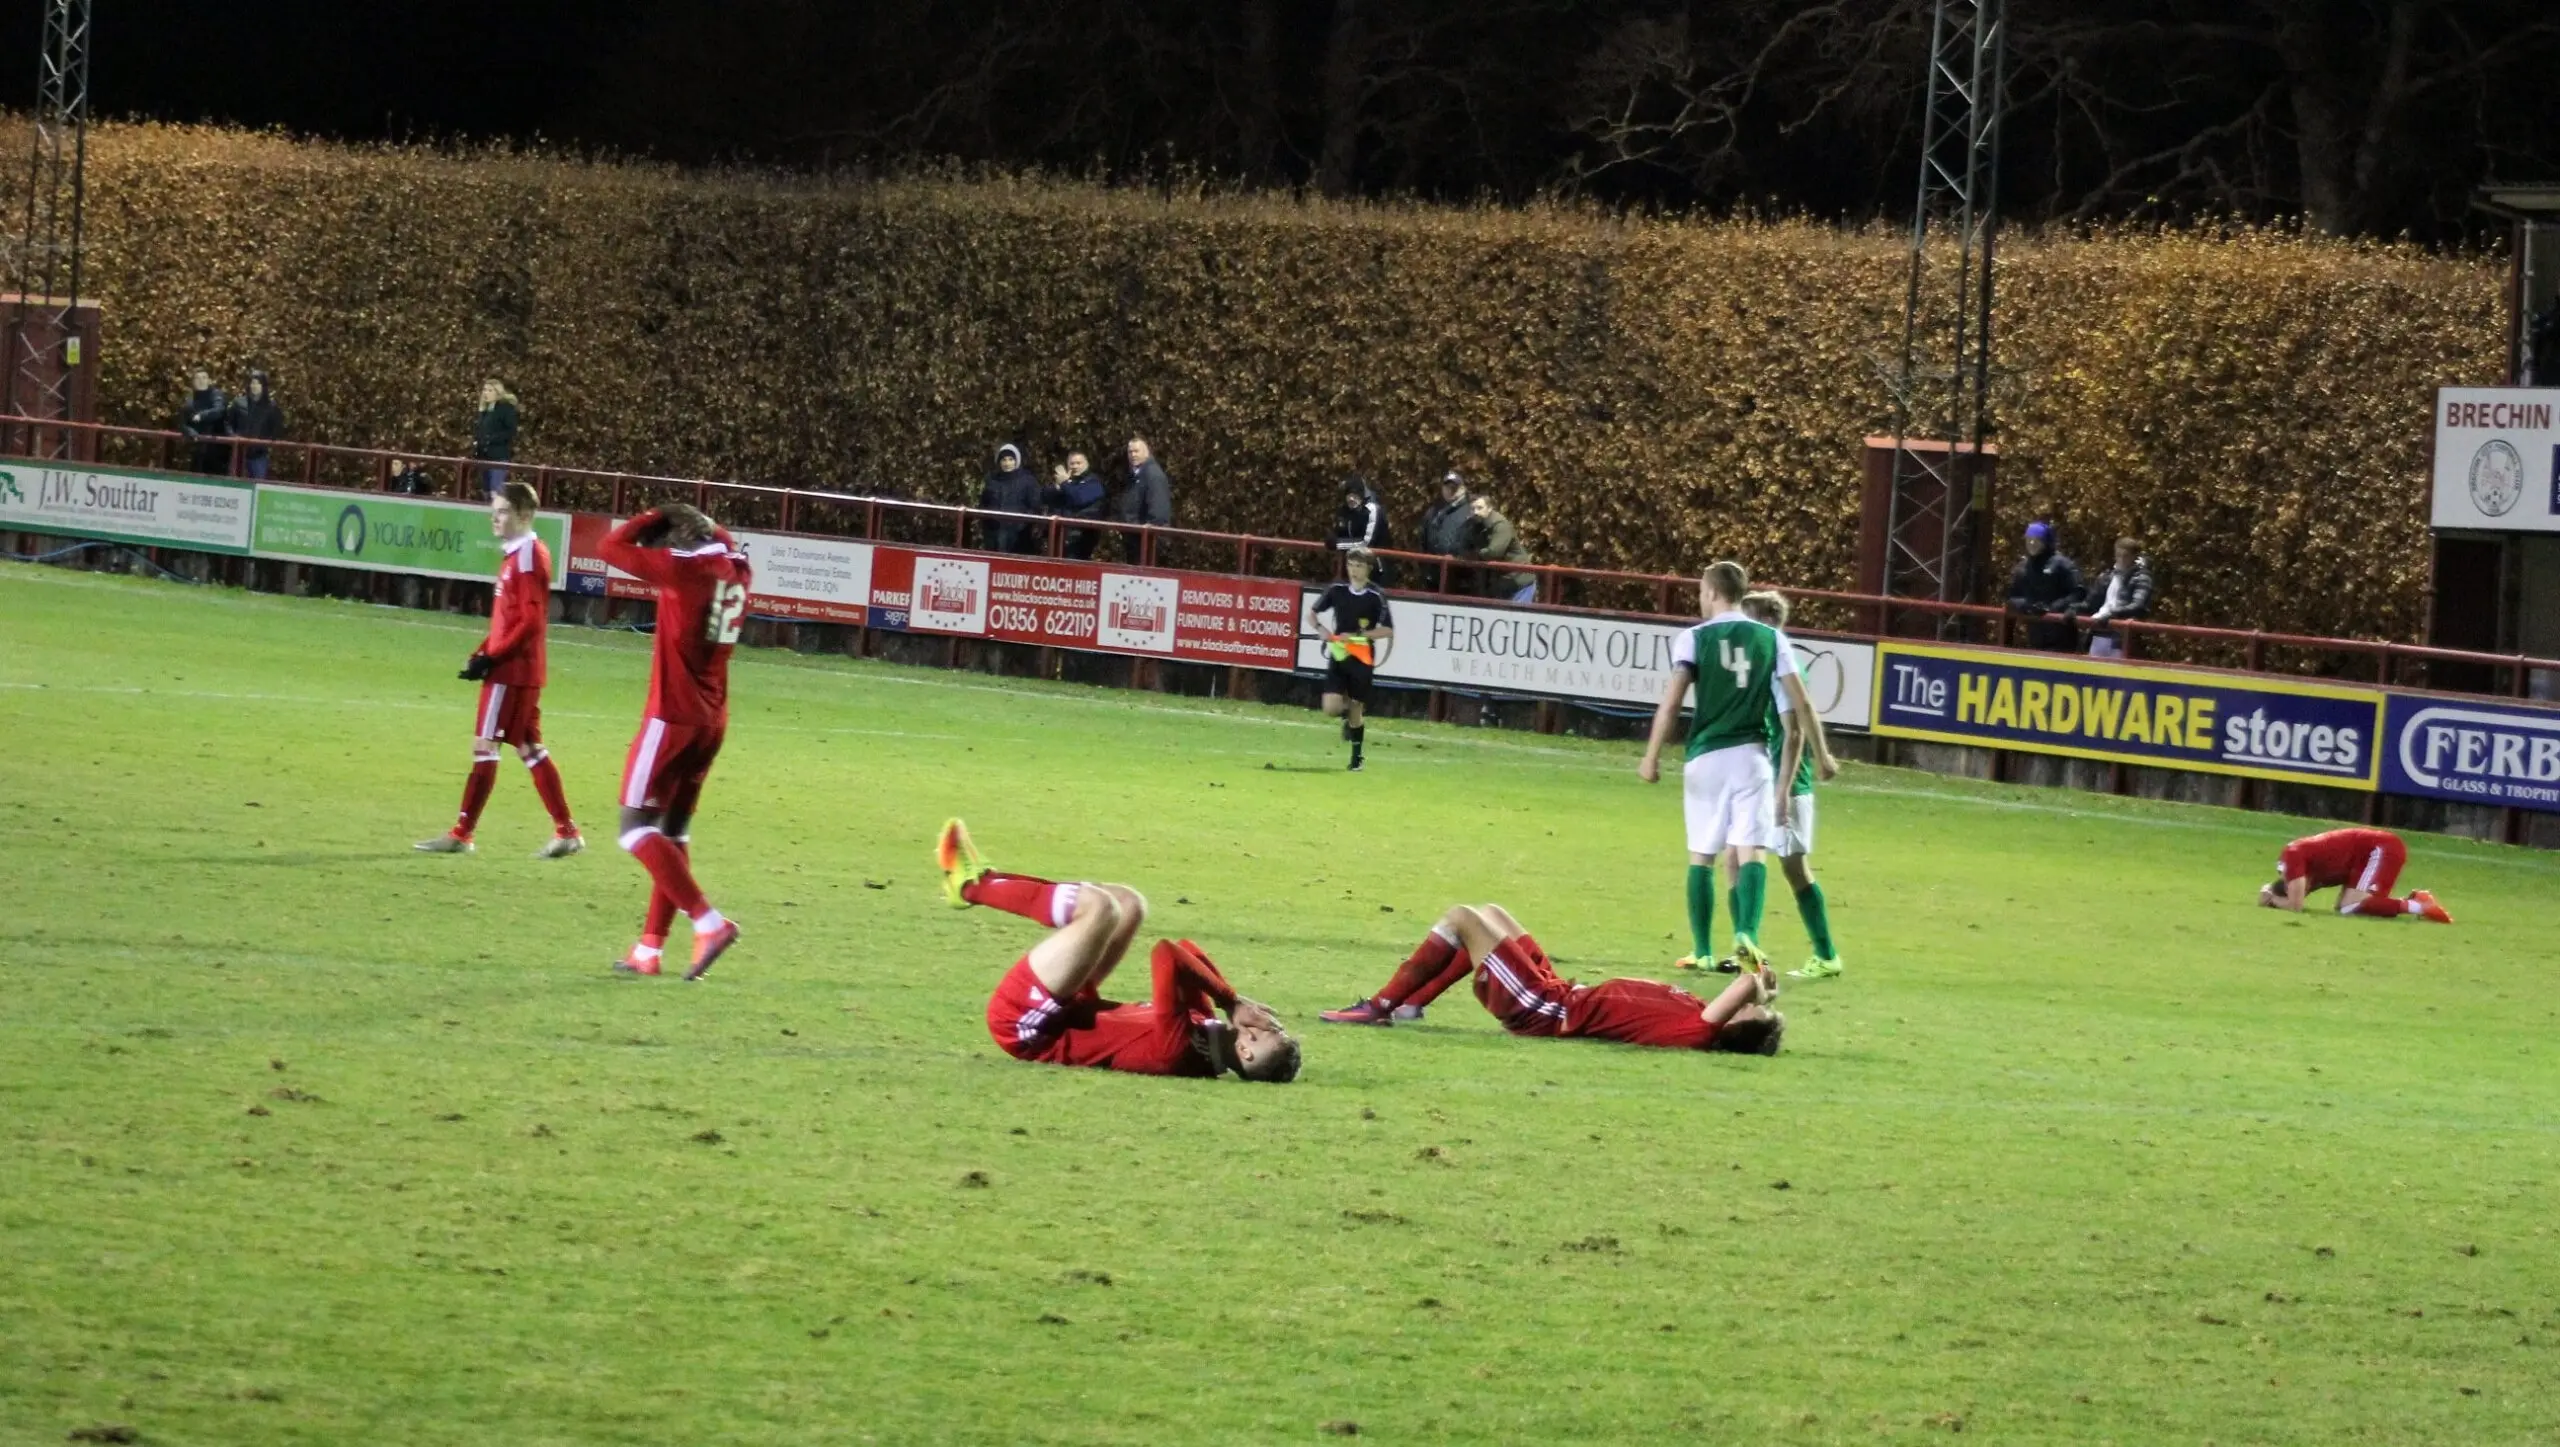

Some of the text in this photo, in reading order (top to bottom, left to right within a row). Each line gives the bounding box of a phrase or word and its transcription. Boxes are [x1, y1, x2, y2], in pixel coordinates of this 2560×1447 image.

[2445, 402, 2551, 430] BRECHIN
[39, 470, 79, 510] J.W.
[84, 474, 159, 514] Souttar
[373, 522, 416, 549] YOUR
[419, 527, 465, 553] MOVE
[992, 572, 1098, 596] LUXURY COACH HIRE
[991, 591, 1097, 609] www.blackscoaches.co.uk
[1181, 589, 1290, 613] REMOVERS & STORERS
[989, 604, 1096, 638] 01356 622119
[1176, 612, 1292, 637] FURNITURE & FLOORING
[1176, 637, 1289, 658] www.blacksofbrechin.com
[1428, 613, 1599, 664] FERGUSON
[1452, 657, 1535, 682] WEALTH
[1717, 639, 1752, 689] 4
[1892, 664, 2360, 766] The HARDWARE stores
[2422, 725, 2560, 783] FERB
[2442, 777, 2560, 803] GLASS & TROPHY
